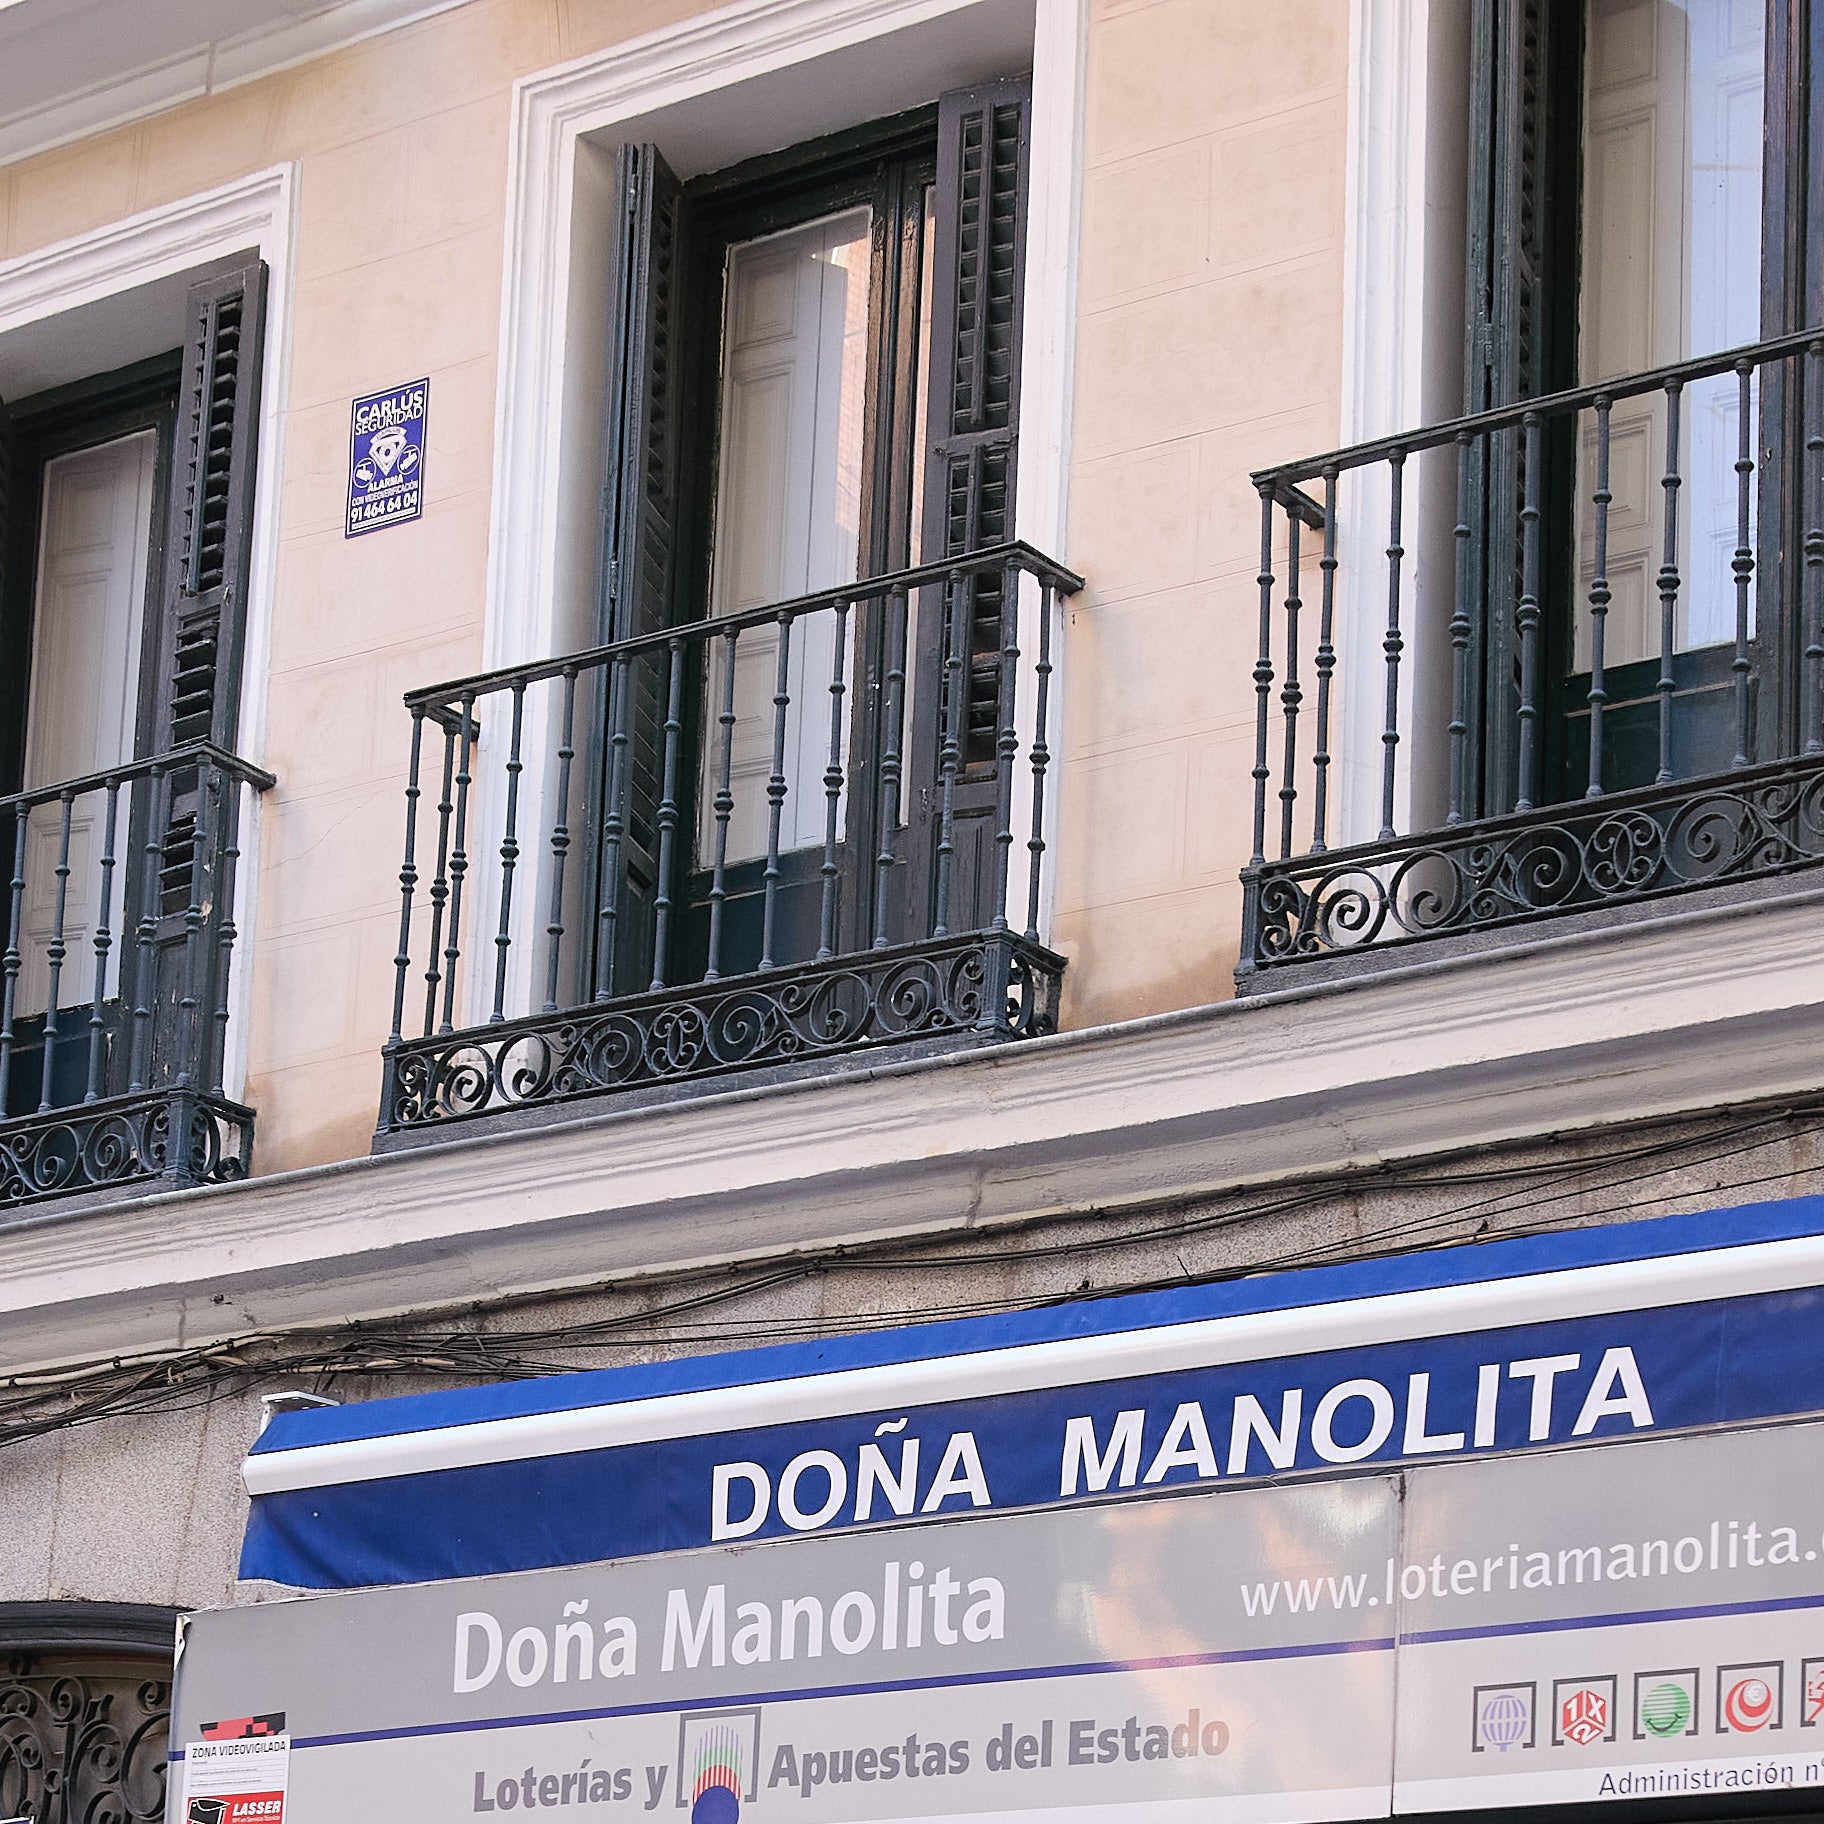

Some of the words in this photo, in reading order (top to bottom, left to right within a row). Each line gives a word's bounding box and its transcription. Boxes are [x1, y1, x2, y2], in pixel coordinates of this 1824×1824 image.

[355, 406, 423, 436] SEGURIDAD
[357, 389, 423, 423] CARLÚS
[367, 474, 403, 493] ALARMA
[351, 507, 363, 522] 91
[364, 500, 384, 519] 464
[387, 496, 401, 515] 64
[403, 491, 418, 510] 04
[712, 1418, 992, 1542] DOÑA
[1060, 1346, 1655, 1498] MANOLITA
[453, 1600, 637, 1694] Doña
[661, 1560, 1008, 1673] Manolita
[192, 1747, 217, 1758] ZONA
[219, 1741, 286, 1757] VIDEOVIGILADA
[475, 1757, 633, 1813] Loterías
[643, 1763, 669, 1810] y
[768, 1732, 980, 1799] Apuestas
[985, 1720, 1053, 1772] del
[1076, 1708, 1230, 1768] Estado
[1598, 1762, 1795, 1796] Administración
[232, 1801, 281, 1816] LASSER
